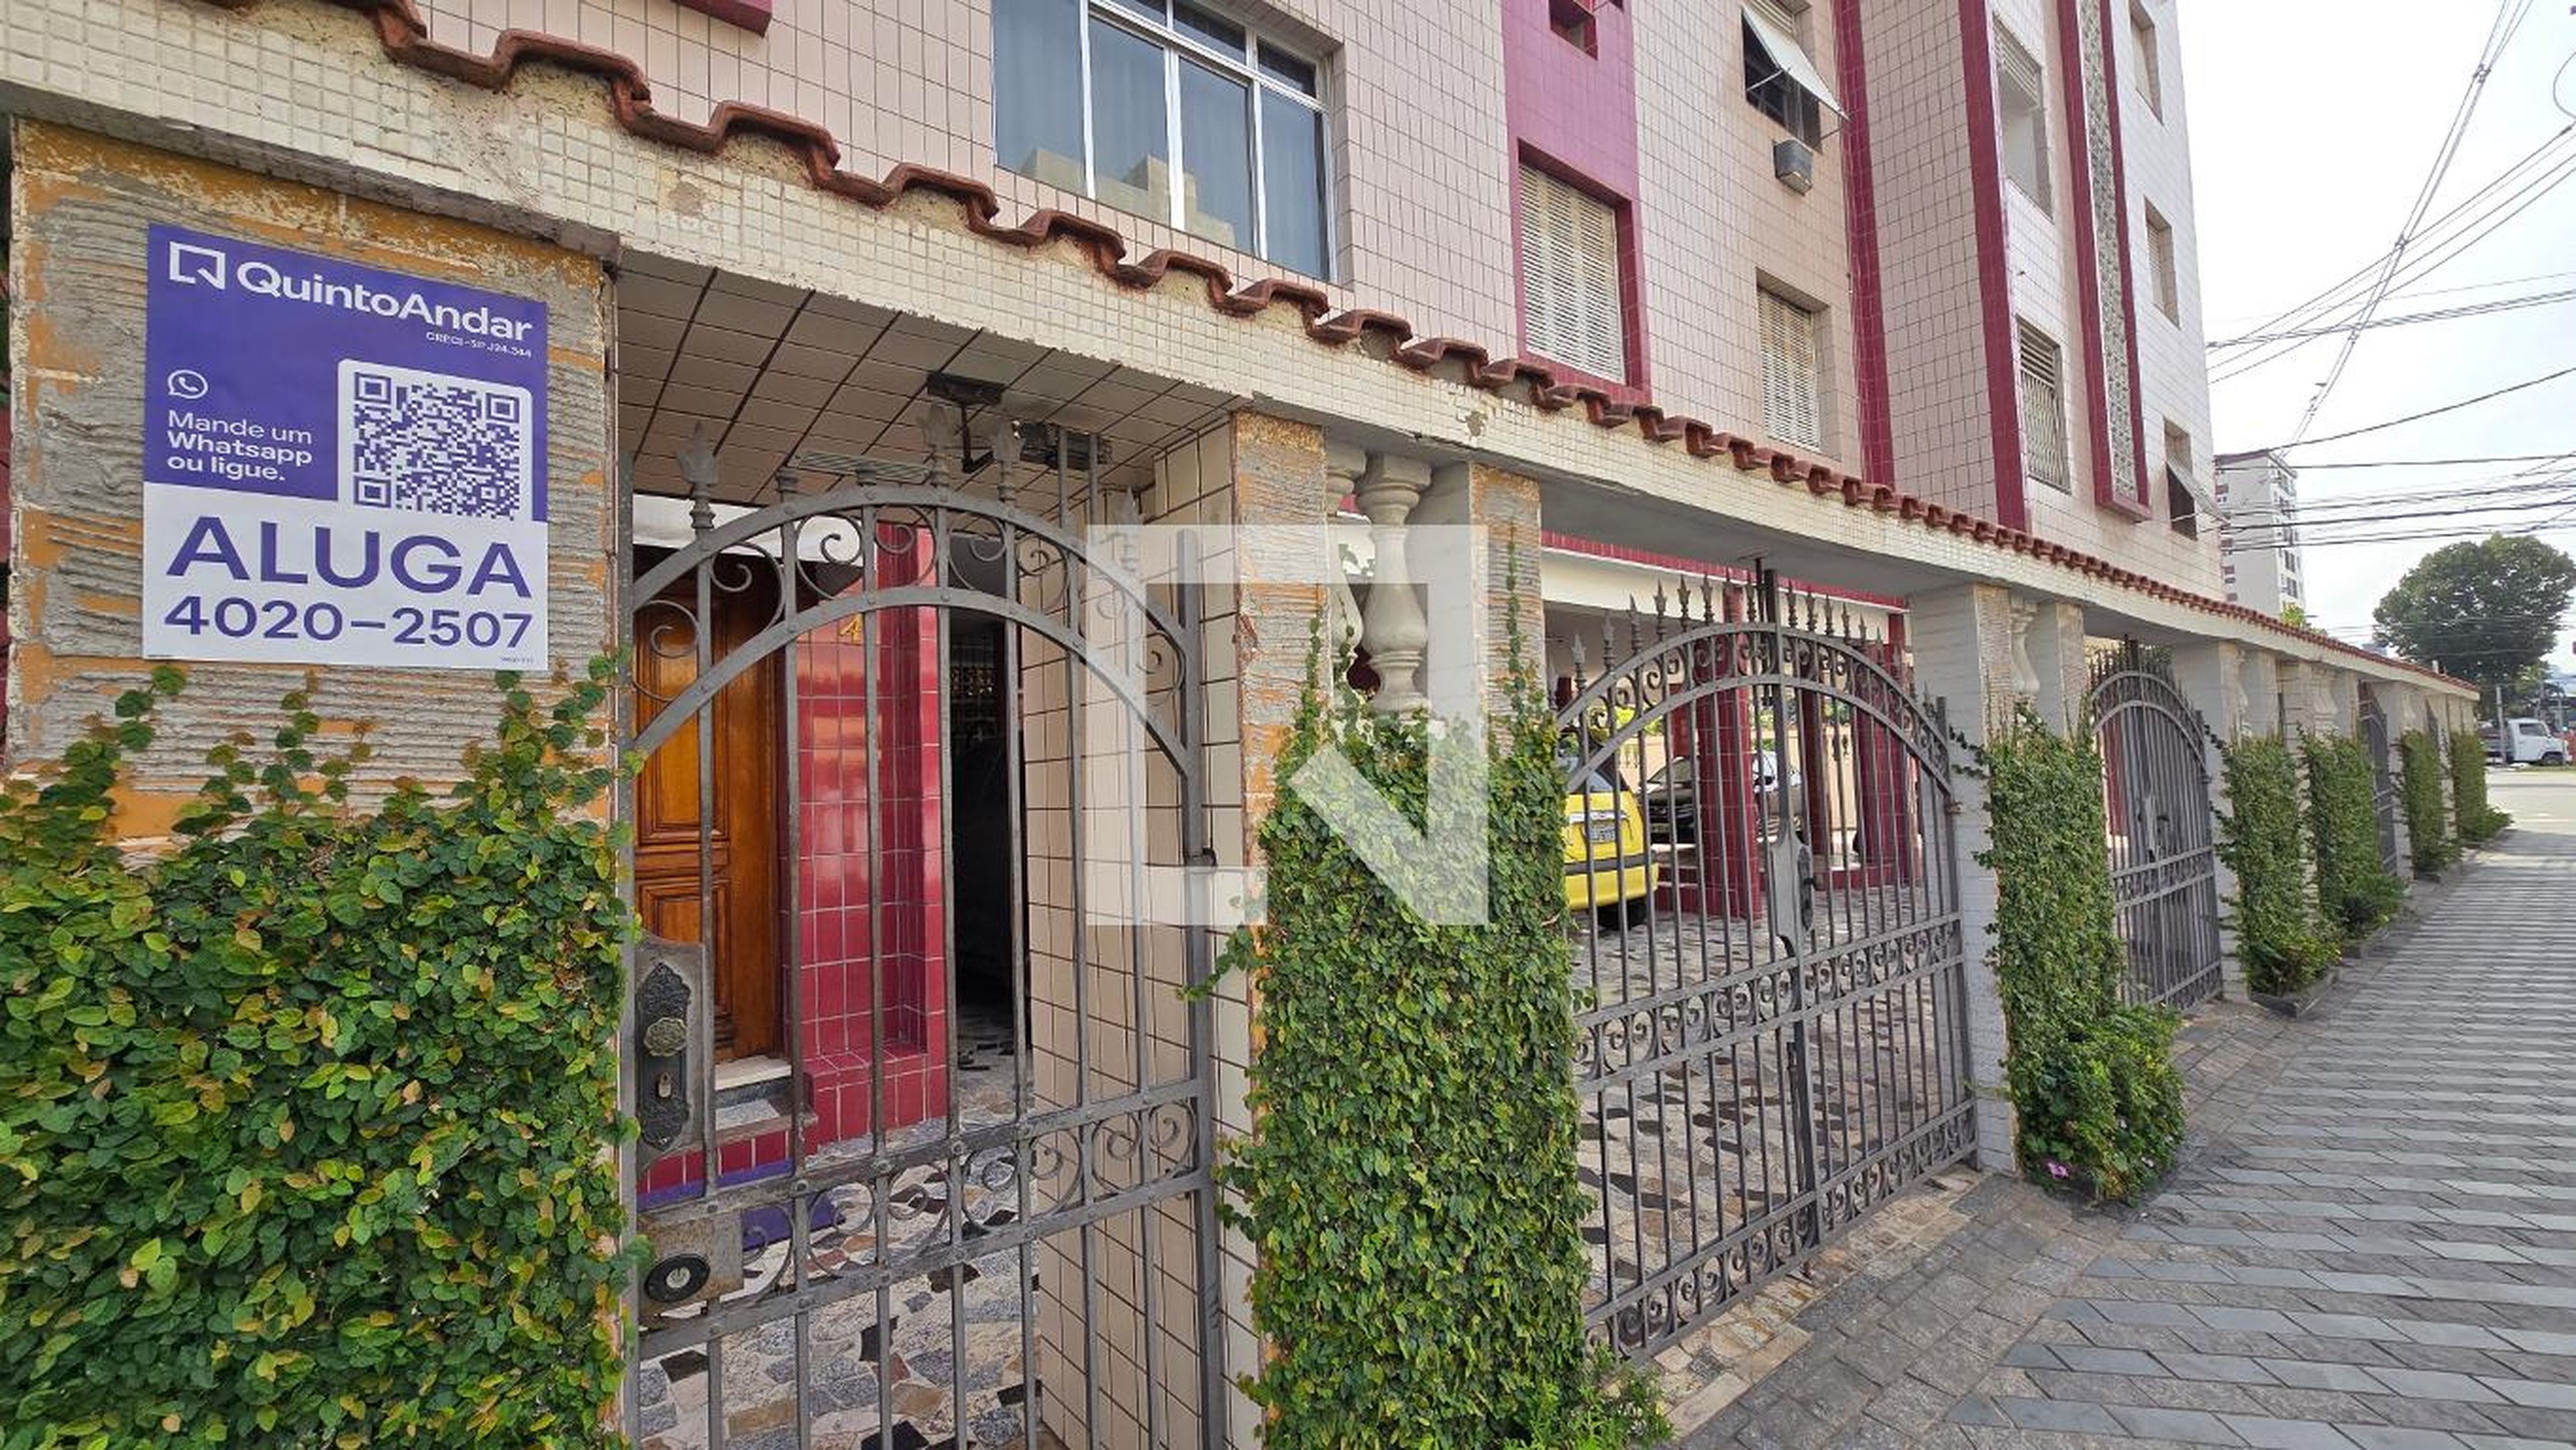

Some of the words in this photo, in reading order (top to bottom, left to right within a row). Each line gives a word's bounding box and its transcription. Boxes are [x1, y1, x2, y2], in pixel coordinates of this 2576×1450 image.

[237, 262, 533, 341] QuintoAndar
[167, 429, 313, 469] Whatsapp
[168, 409, 265, 440] Mande
[271, 427, 313, 445] um
[167, 456, 204, 472] ou
[210, 456, 286, 482] ligue.
[165, 515, 533, 599] ALUGA
[164, 595, 533, 649] 4020-2507
